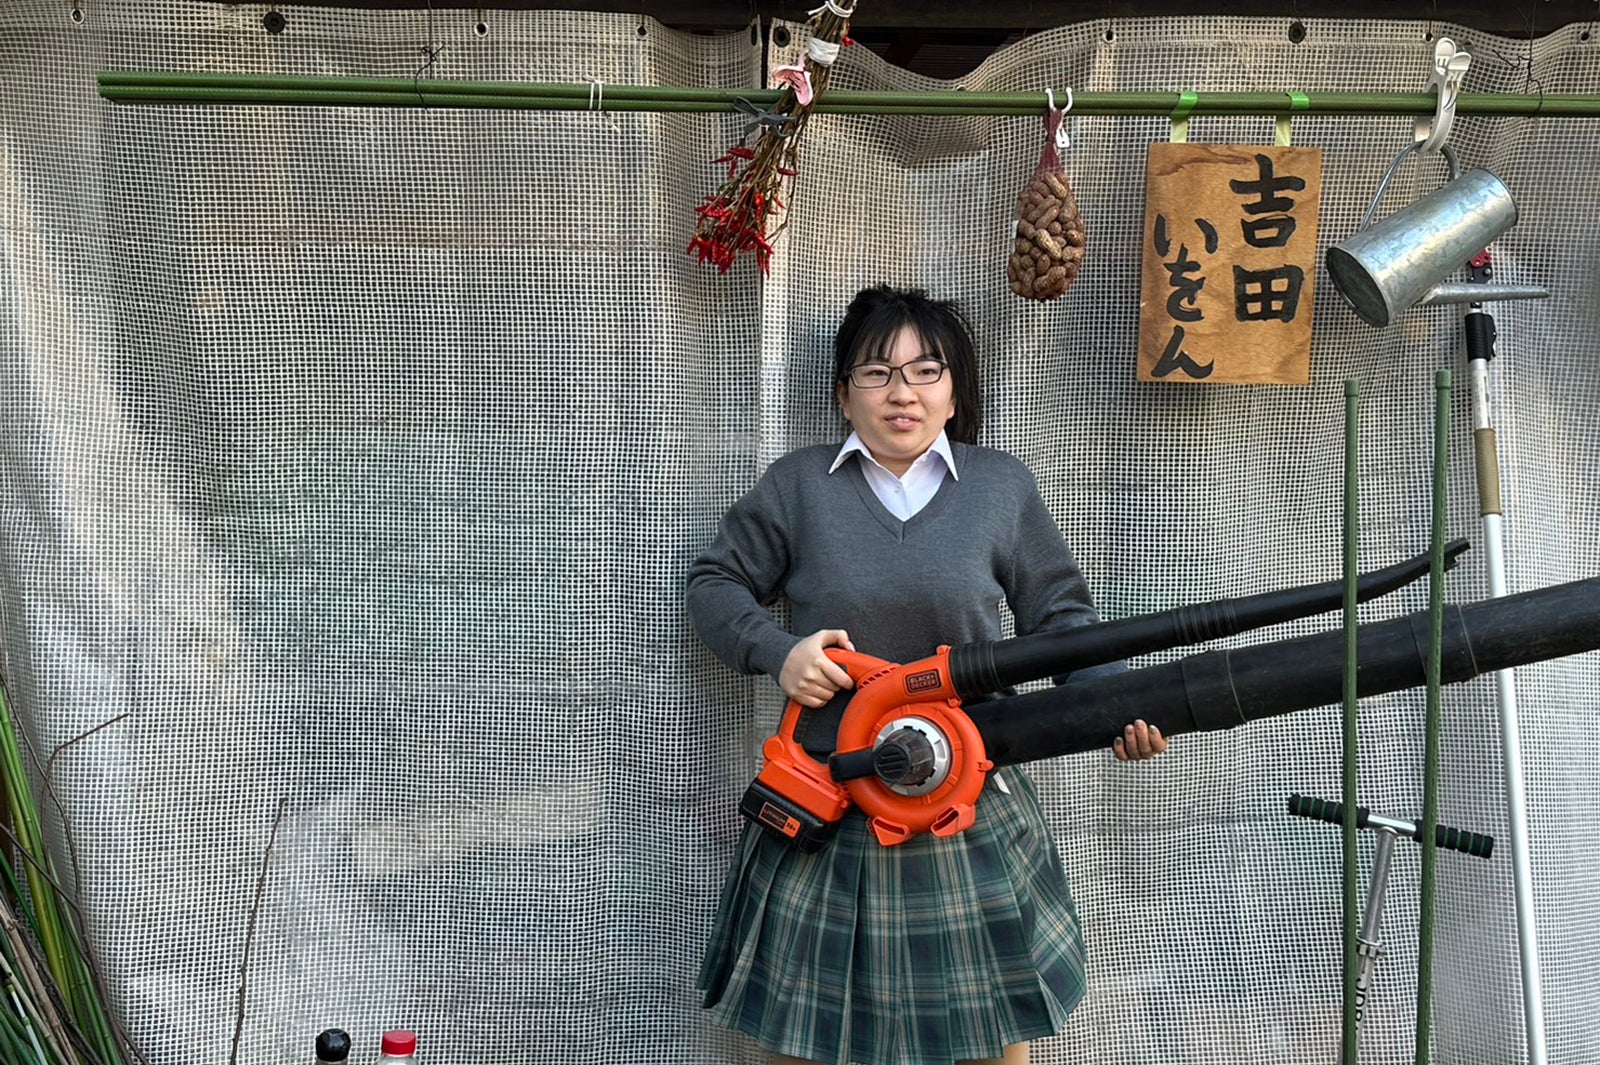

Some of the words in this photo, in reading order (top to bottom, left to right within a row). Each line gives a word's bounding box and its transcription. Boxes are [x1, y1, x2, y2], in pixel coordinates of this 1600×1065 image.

[1151, 213, 1219, 379] いをん
[1229, 153, 1306, 323] 吉田
